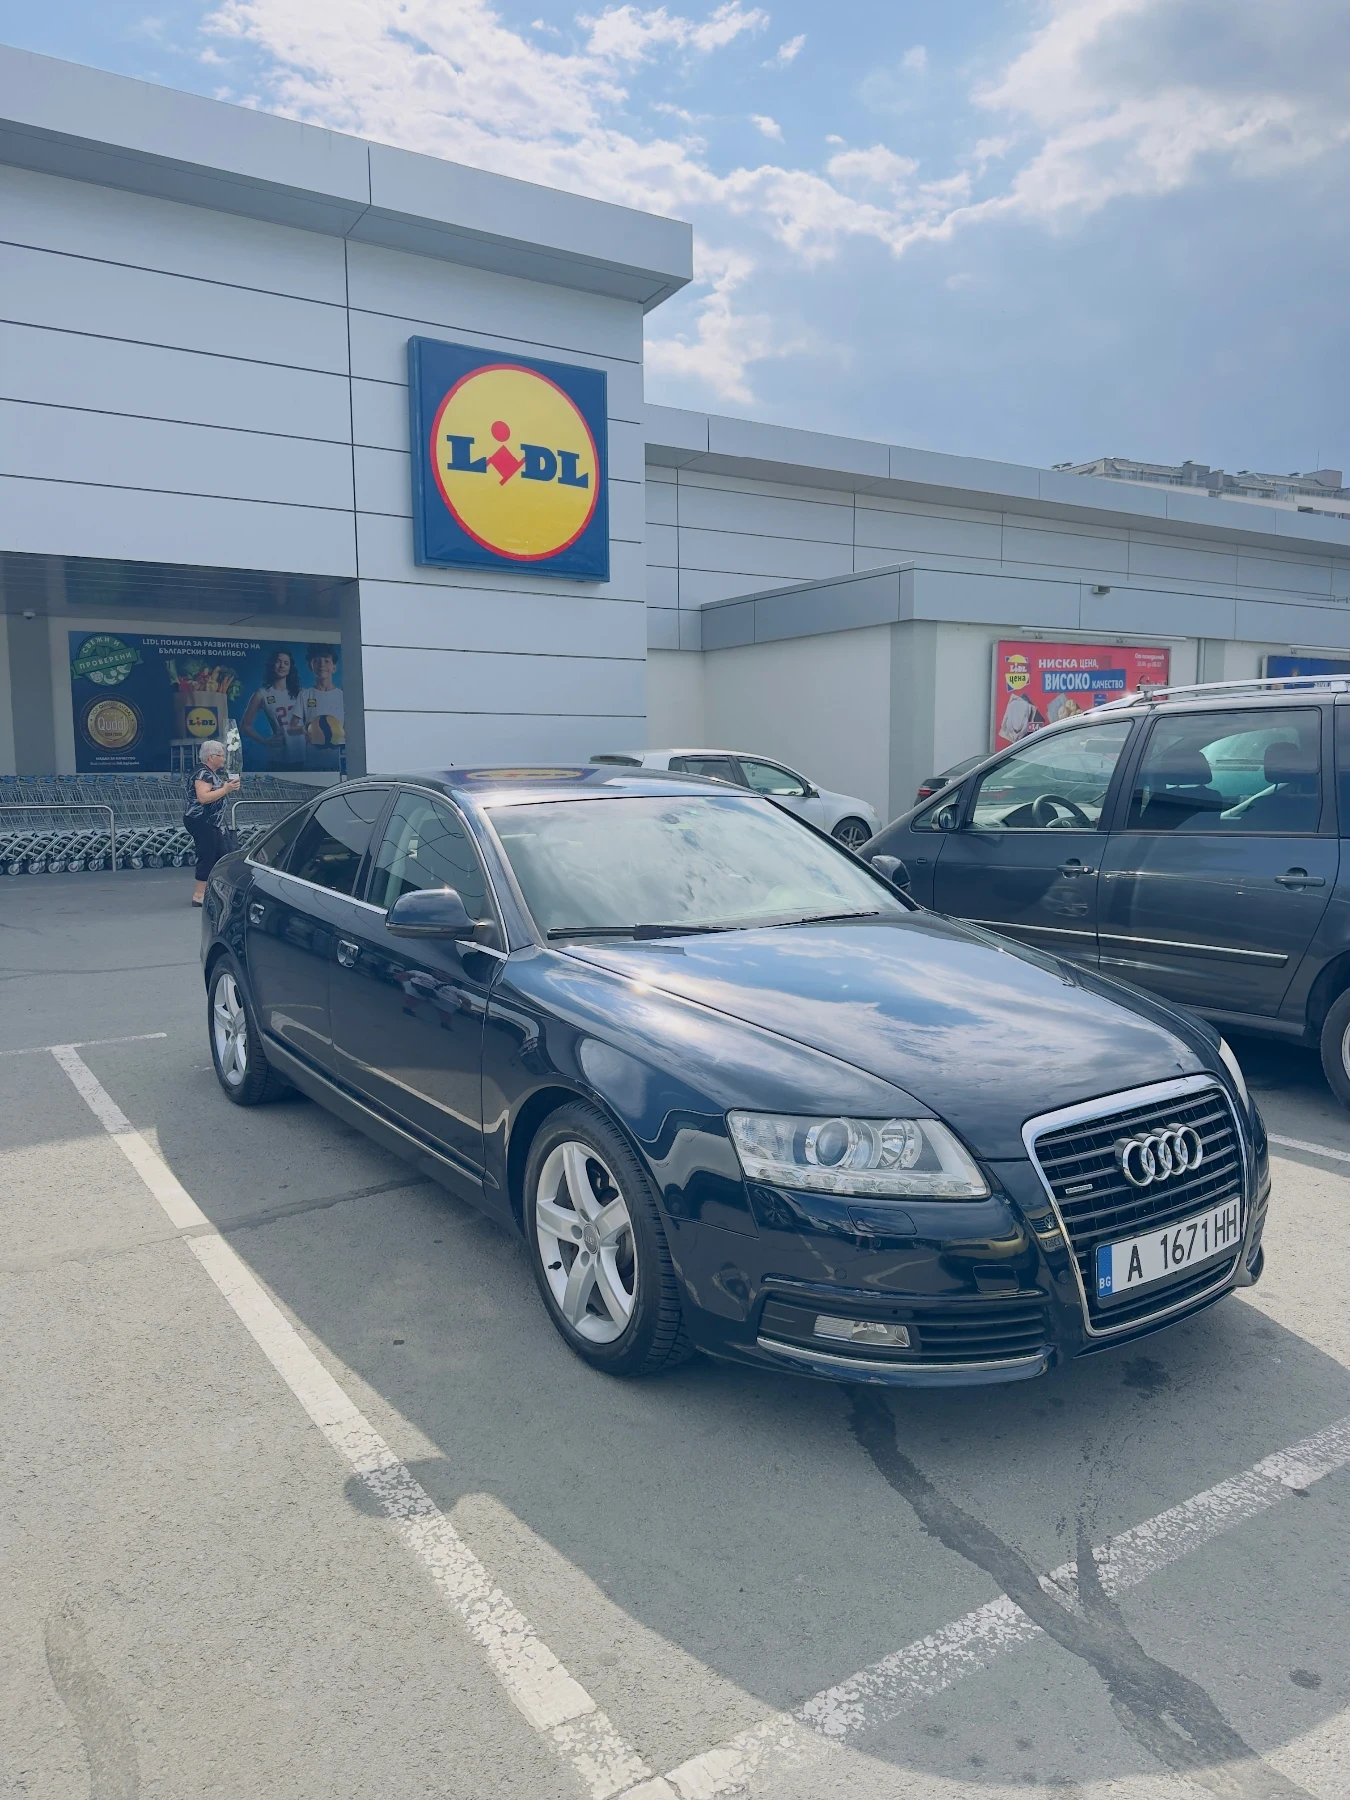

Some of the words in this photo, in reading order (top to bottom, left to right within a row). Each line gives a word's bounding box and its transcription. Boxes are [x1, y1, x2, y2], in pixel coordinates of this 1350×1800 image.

[82, 636, 110, 654] СВЕЖИ
[113, 639, 120, 647] И
[142, 638, 160, 646] LIDL
[160, 639, 192, 647] ПОМАГА
[203, 641, 249, 649] РАЗВИТИЕТО
[159, 647, 207, 656] БЪЛГАРСКИЯ
[207, 649, 247, 657] ВОЛЕЙБОЛ
[79, 652, 132, 670] ПРОВЕРЕНИ
[1038, 658, 1078, 669] НИСКА
[1079, 658, 1099, 669] ЦЕНА,
[1009, 675, 1026, 684] цена
[1044, 672, 1091, 691] ВИСОКО
[1091, 679, 1124, 689] КАЧЕСТВО
[1127, 1243, 1144, 1283] A
[1099, 1276, 1112, 1290] BG
